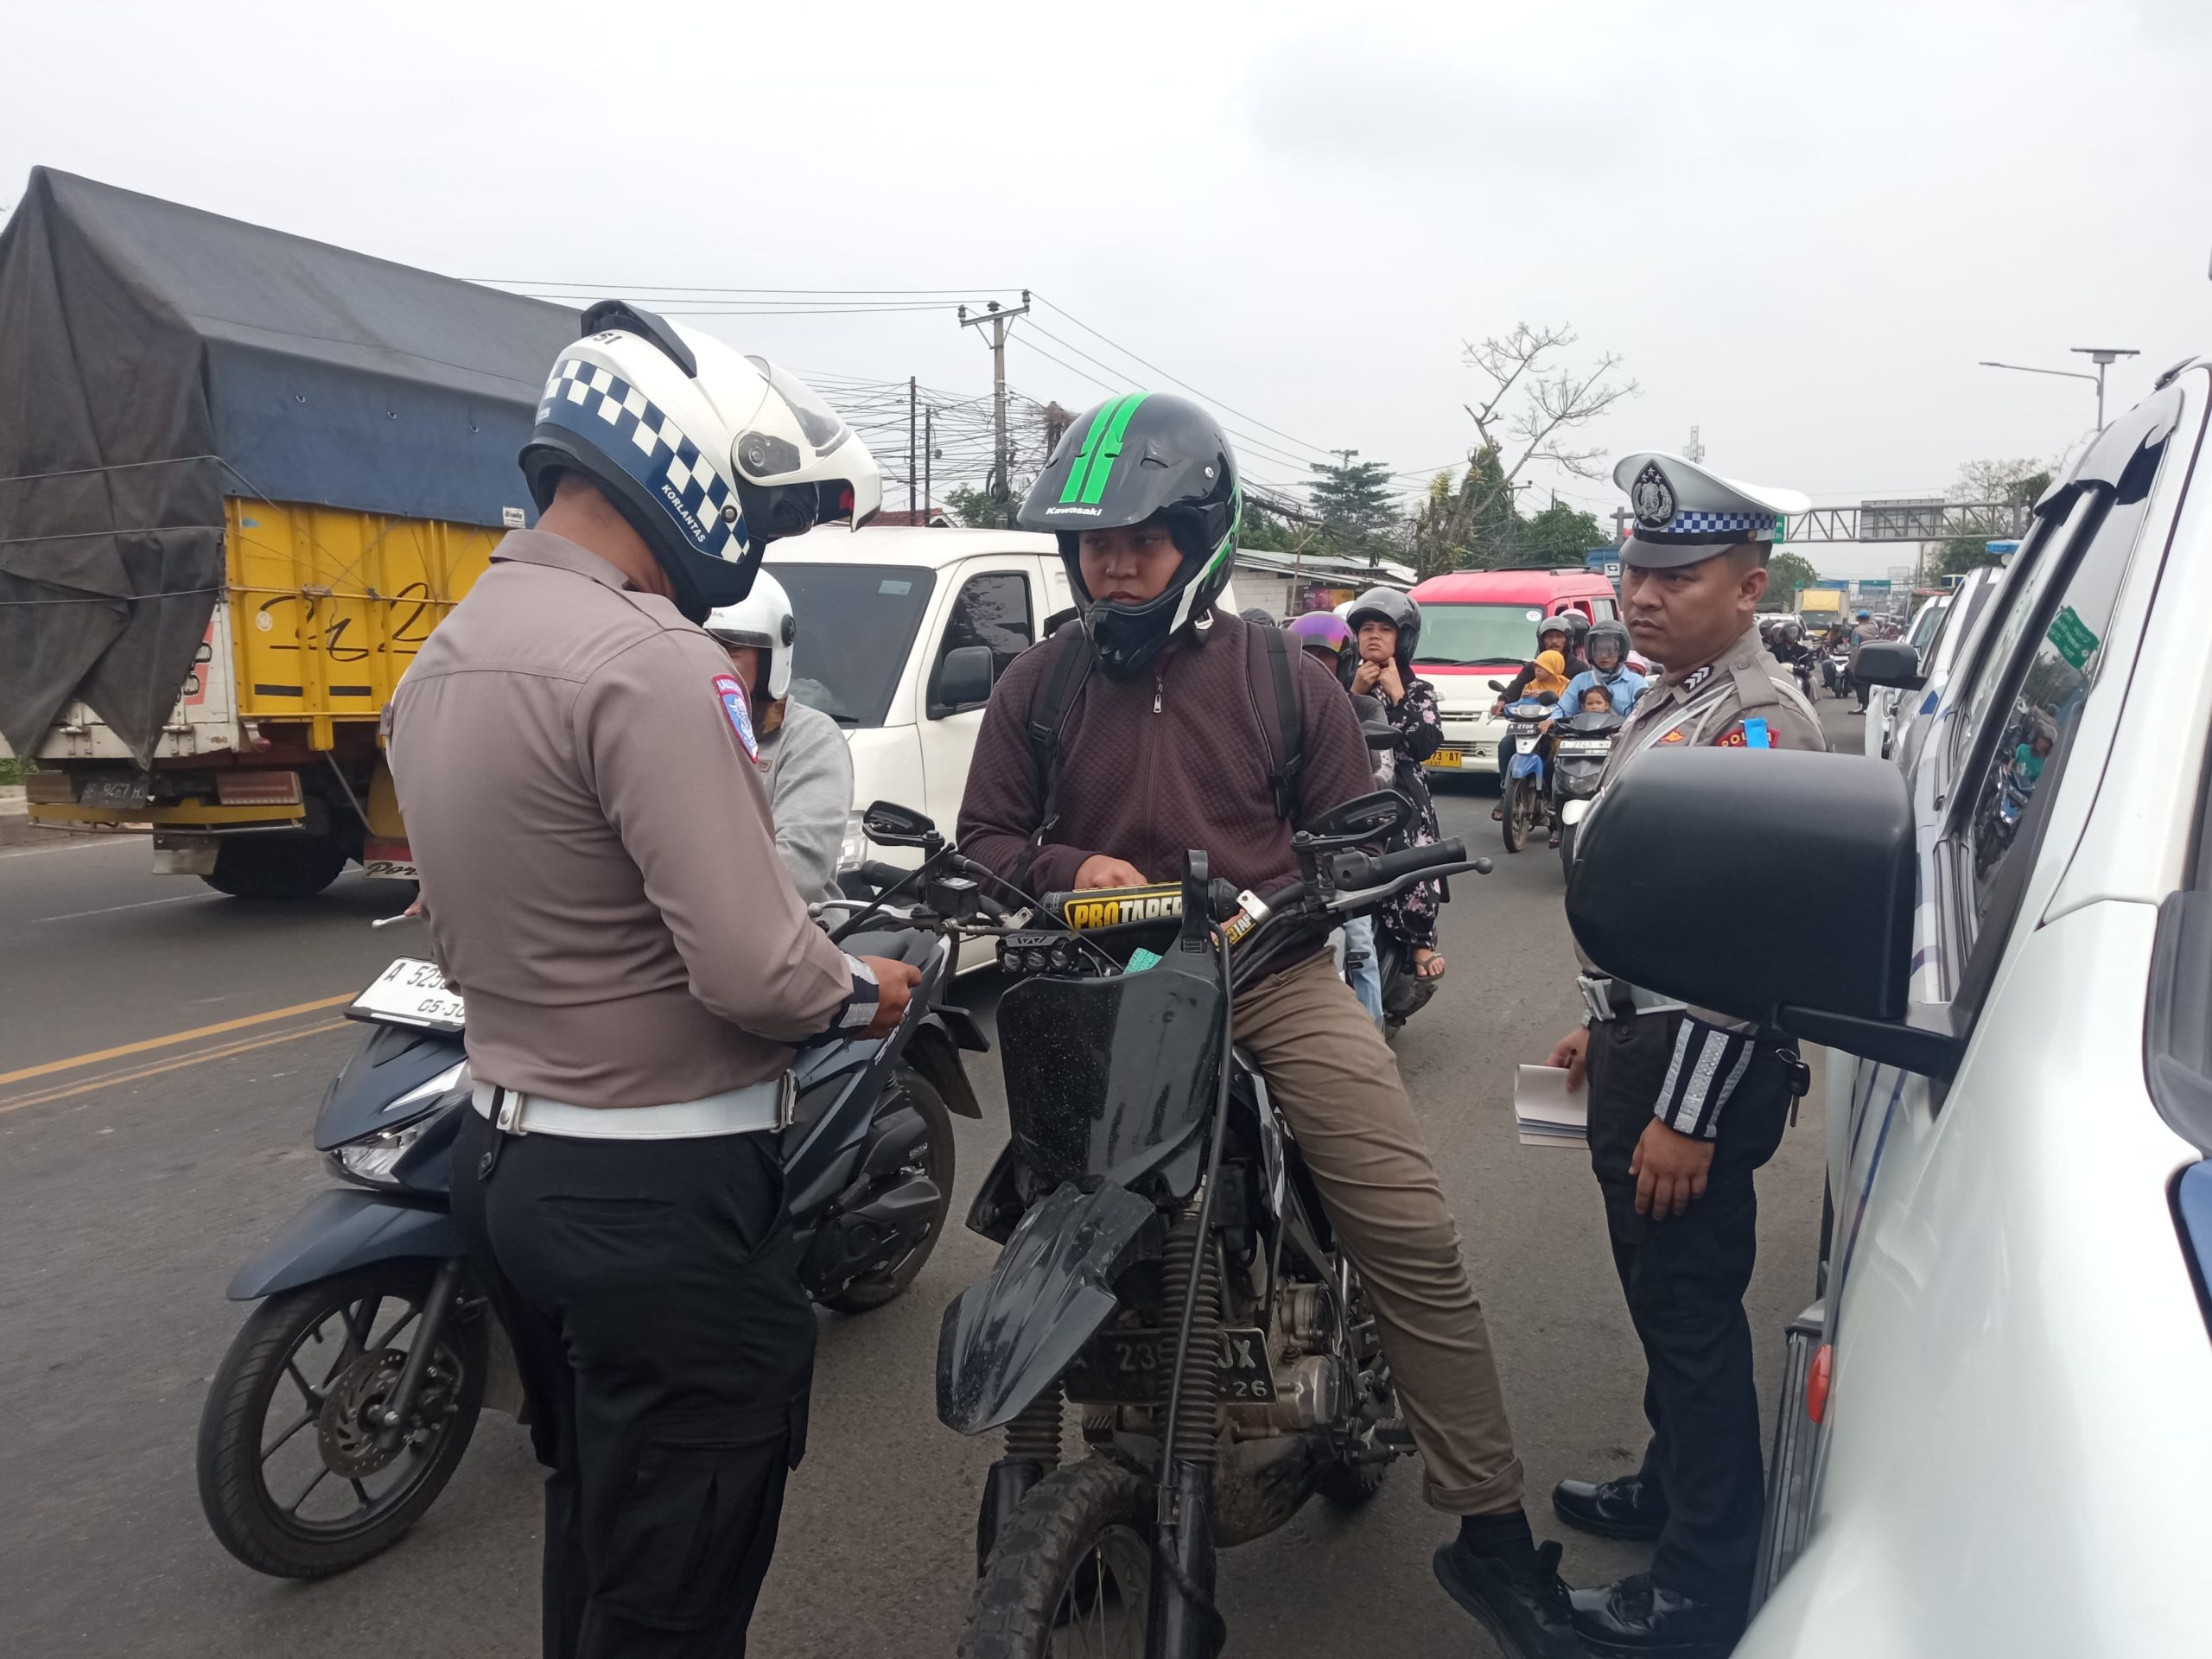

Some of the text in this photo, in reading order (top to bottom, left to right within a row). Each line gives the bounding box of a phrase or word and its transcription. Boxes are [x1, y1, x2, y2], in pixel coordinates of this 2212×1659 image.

[661, 484, 706, 543] KORLANTAS
[1046, 503, 1103, 517] Kawasaki
[1721, 731, 1771, 747] POLI
[1449, 753, 1459, 761] AT
[384, 962, 406, 982] A
